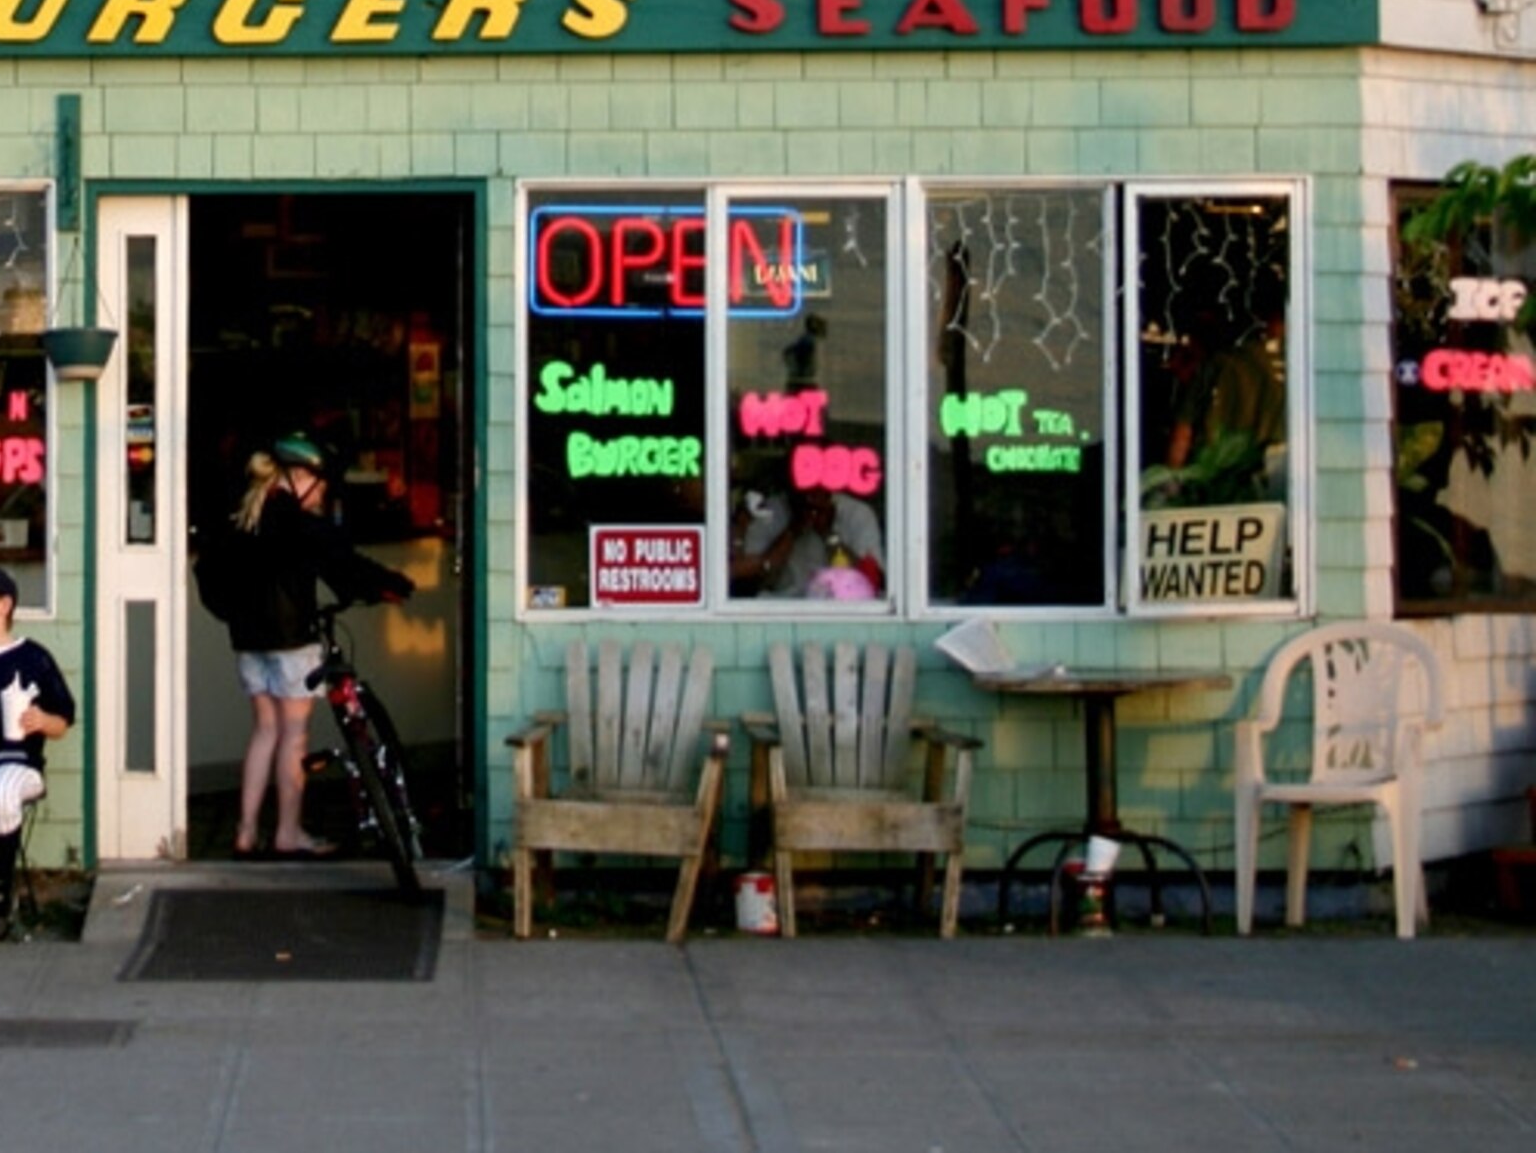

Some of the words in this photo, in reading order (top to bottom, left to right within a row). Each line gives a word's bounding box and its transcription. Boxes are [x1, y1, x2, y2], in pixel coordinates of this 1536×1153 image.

[536, 215, 794, 309] OPEN
[739, 389, 829, 438] HOT
[939, 388, 1028, 438] HOT
[566, 430, 702, 479] BURGER
[792, 444, 883, 496] DOG
[603, 537, 628, 564] NO
[634, 537, 694, 564] PUBLIC
[1145, 515, 1264, 559] HELP
[598, 567, 698, 593] RESTROOMS
[1139, 558, 1266, 601] WANTED
